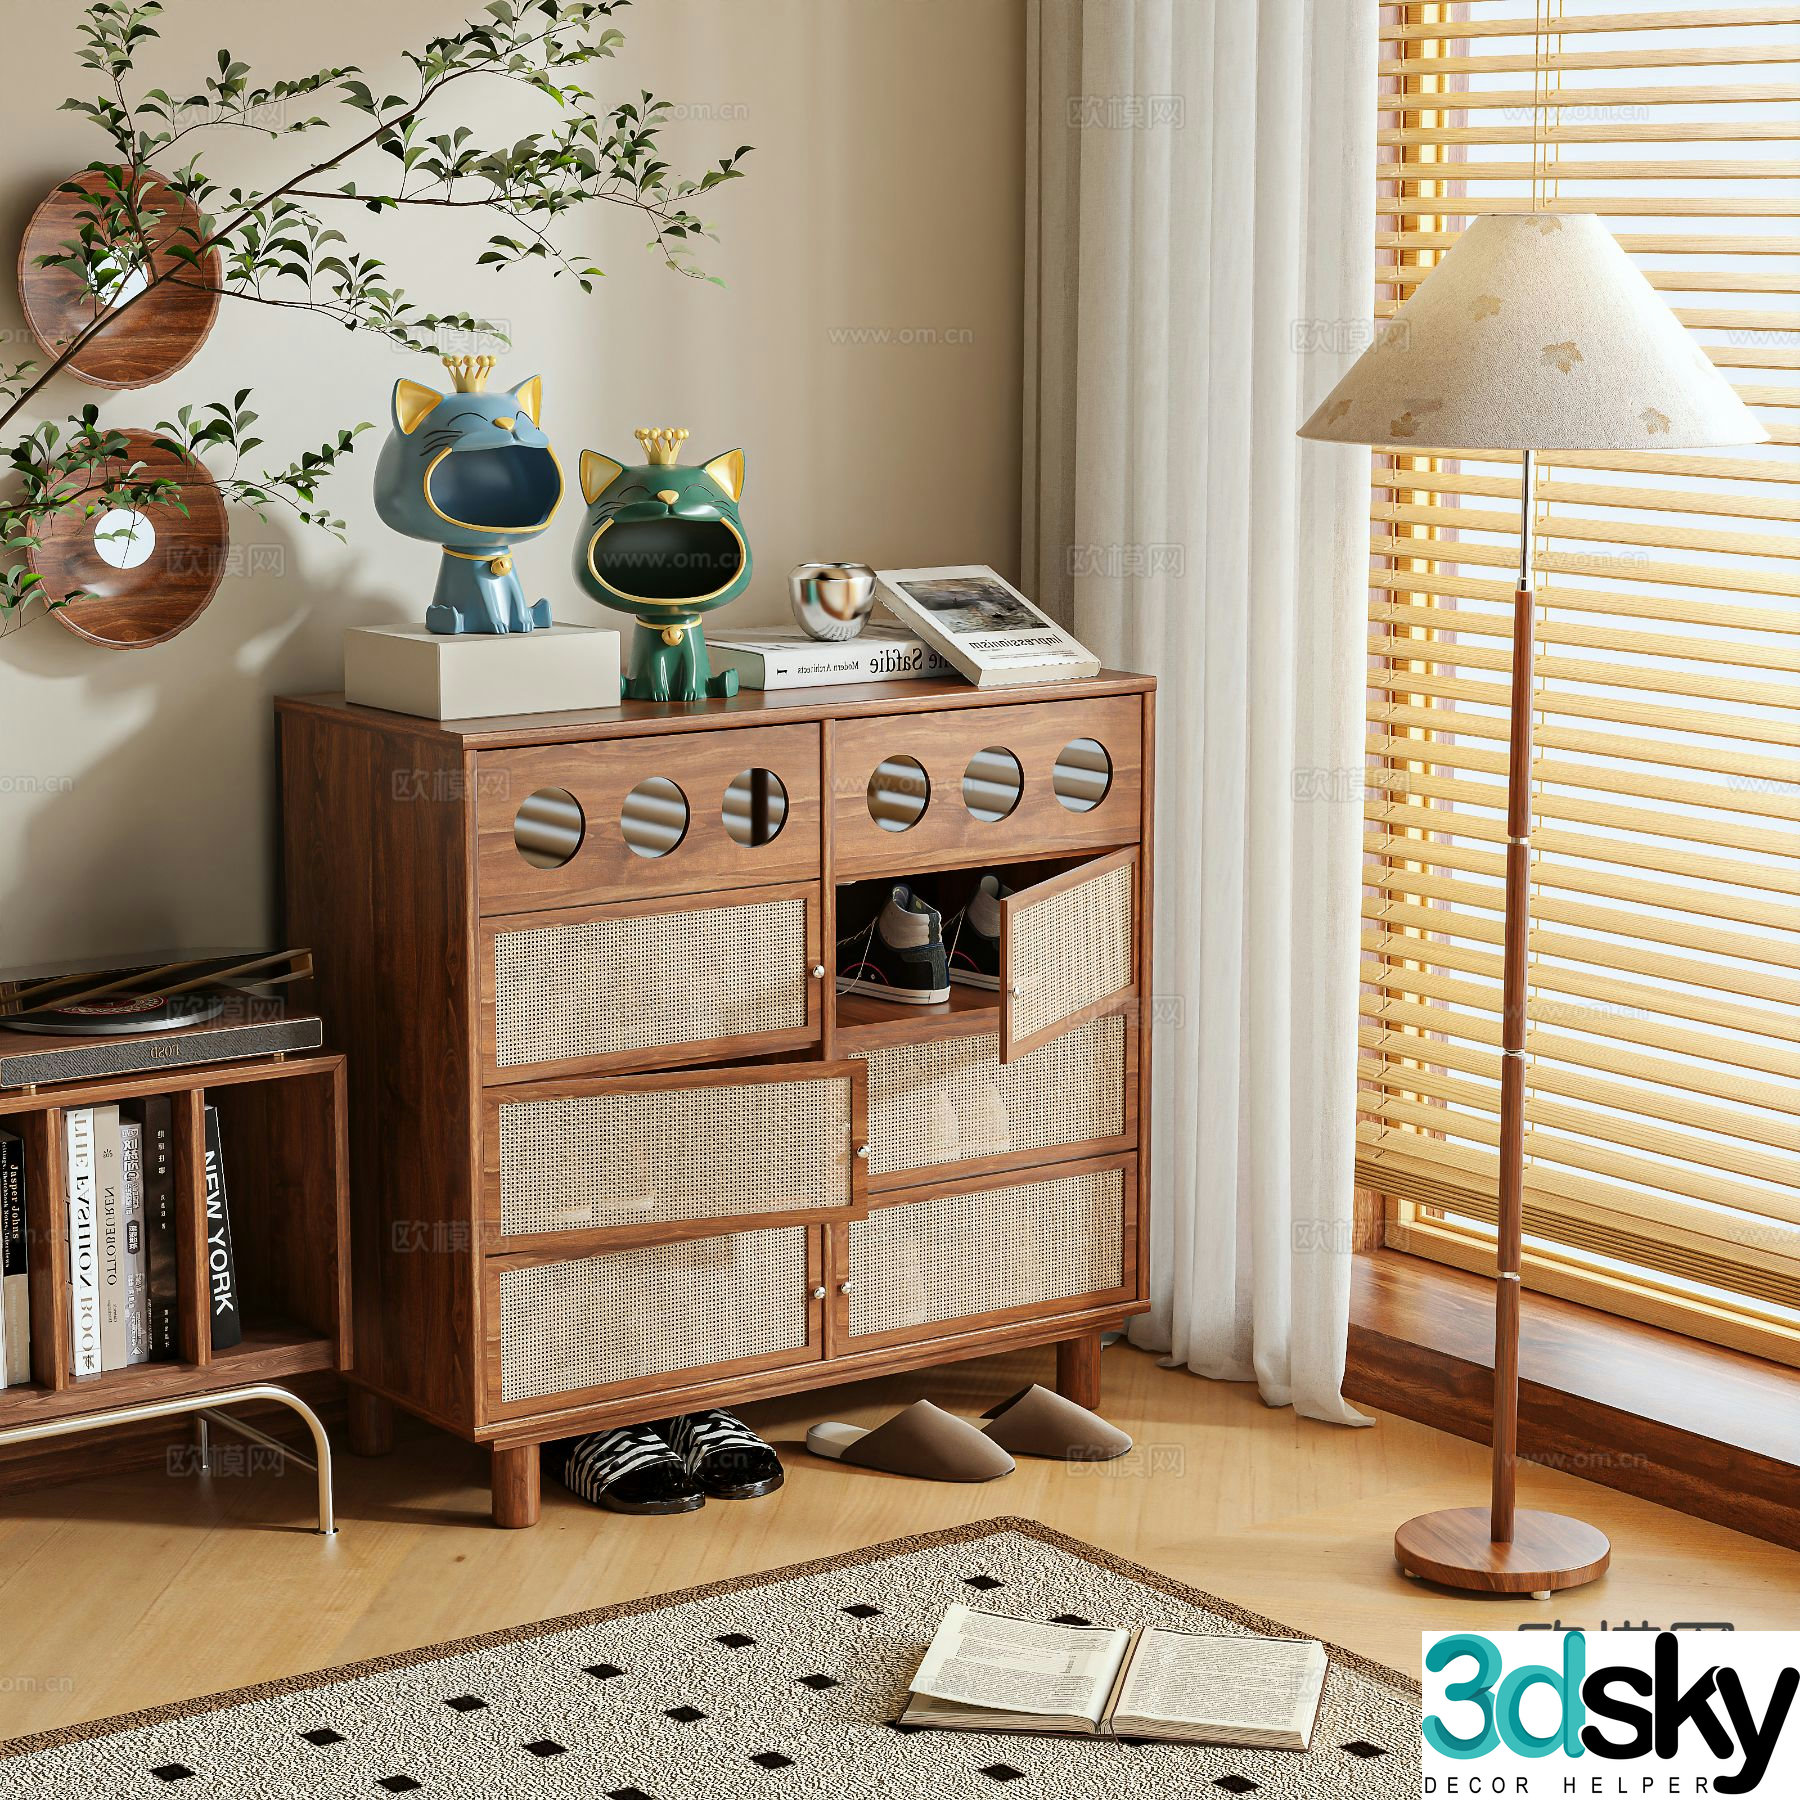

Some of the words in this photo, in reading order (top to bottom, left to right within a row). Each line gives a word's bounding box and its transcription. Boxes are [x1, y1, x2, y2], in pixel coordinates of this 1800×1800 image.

[10, 1164, 19, 1202] Jasper
[205, 1150, 222, 1219] NEW
[11, 1206, 21, 1239] Johns
[208, 1226, 234, 1316] YORK
